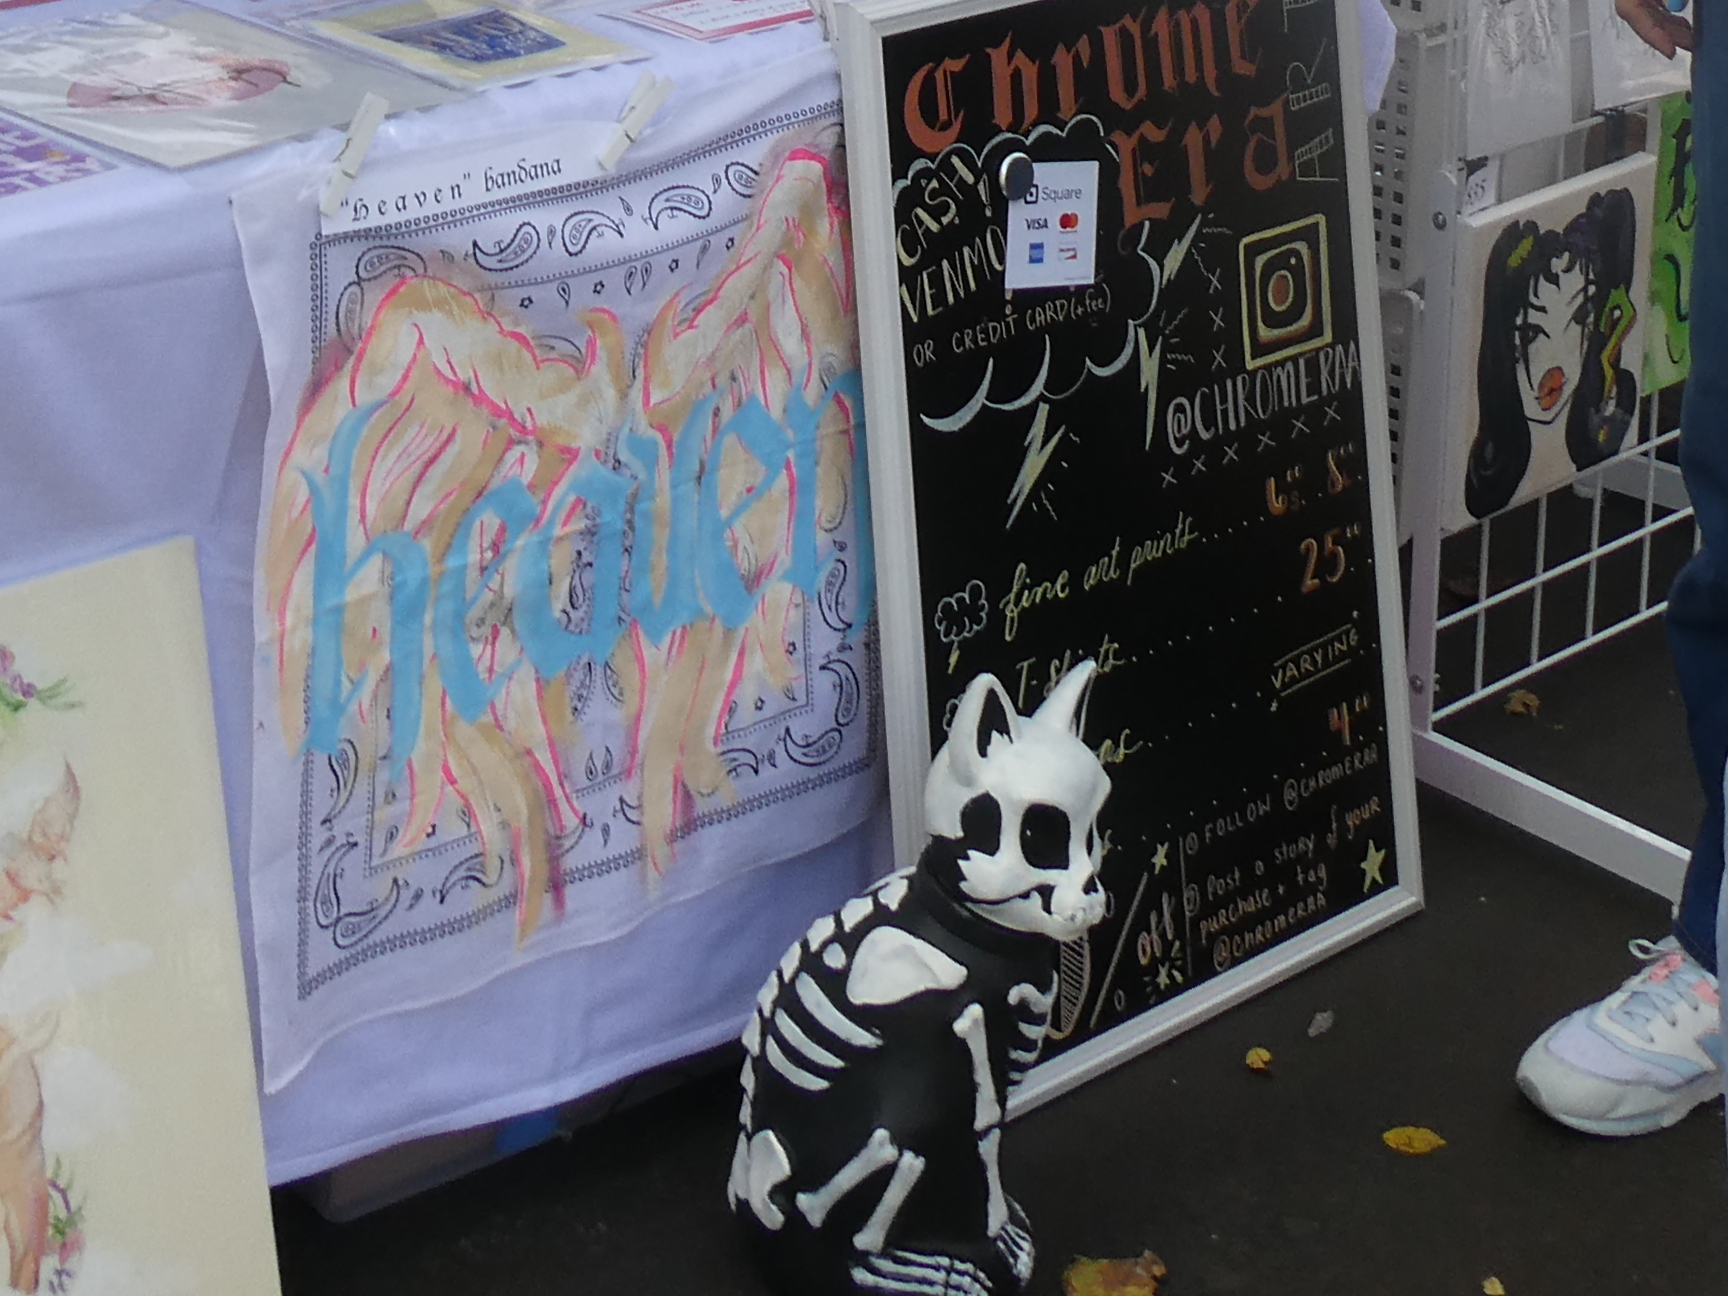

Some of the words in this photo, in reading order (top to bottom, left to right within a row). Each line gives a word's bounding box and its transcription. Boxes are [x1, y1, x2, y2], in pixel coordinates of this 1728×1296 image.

[1108, 88, 1293, 232] Era
[1041, 186, 1083, 204] Square
[1024, 217, 1049, 231] VISA
[912, 339, 937, 367] OR
[951, 313, 1018, 354] CREDIT
[999, 561, 1070, 642] fine
[1083, 535, 1121, 591] art
[1127, 510, 1199, 586] prints
[1270, 627, 1360, 691] VARYING
[1204, 792, 1272, 846] FOLLOW
